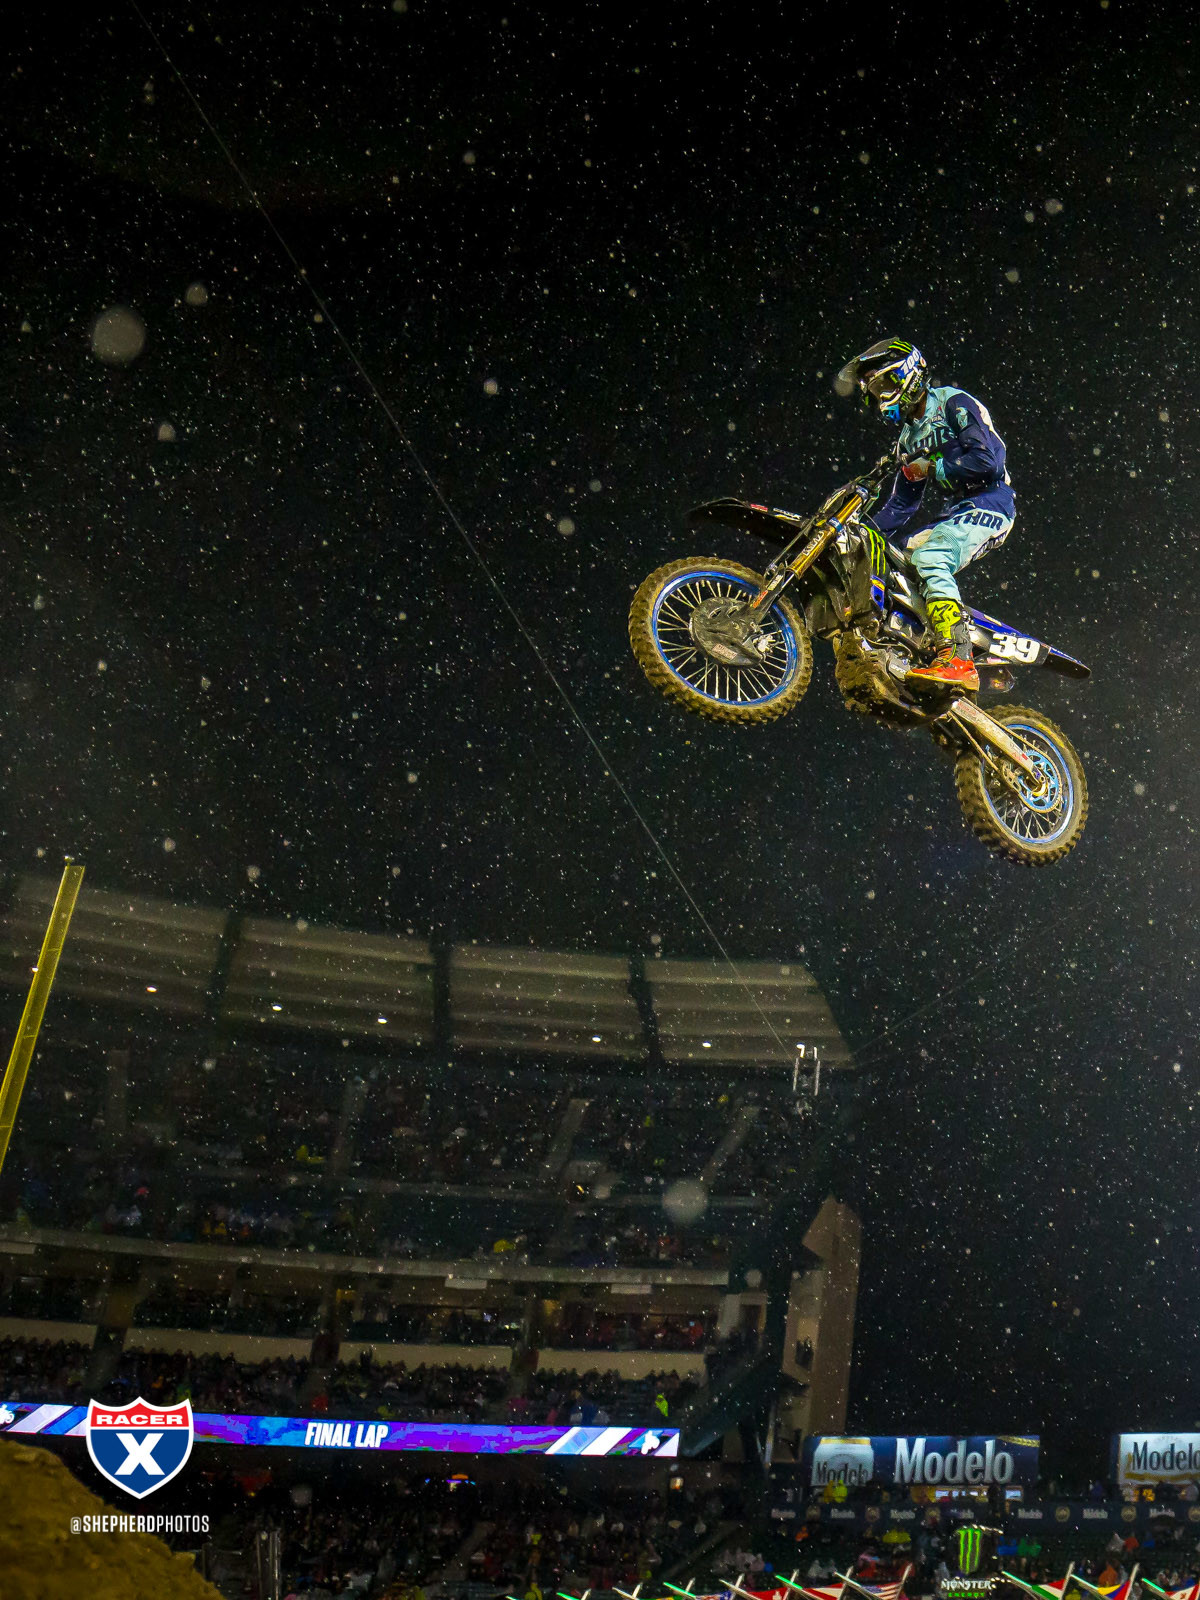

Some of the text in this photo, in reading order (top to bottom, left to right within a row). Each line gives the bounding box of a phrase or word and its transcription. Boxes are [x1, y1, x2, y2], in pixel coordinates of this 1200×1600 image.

[953, 511, 1004, 531] THOR
[989, 632, 1041, 664] 39
[304, 1422, 389, 1448] FINAL LAP
[893, 1437, 1015, 1485] Modelo
[941, 1578, 992, 1591] MONSTER
